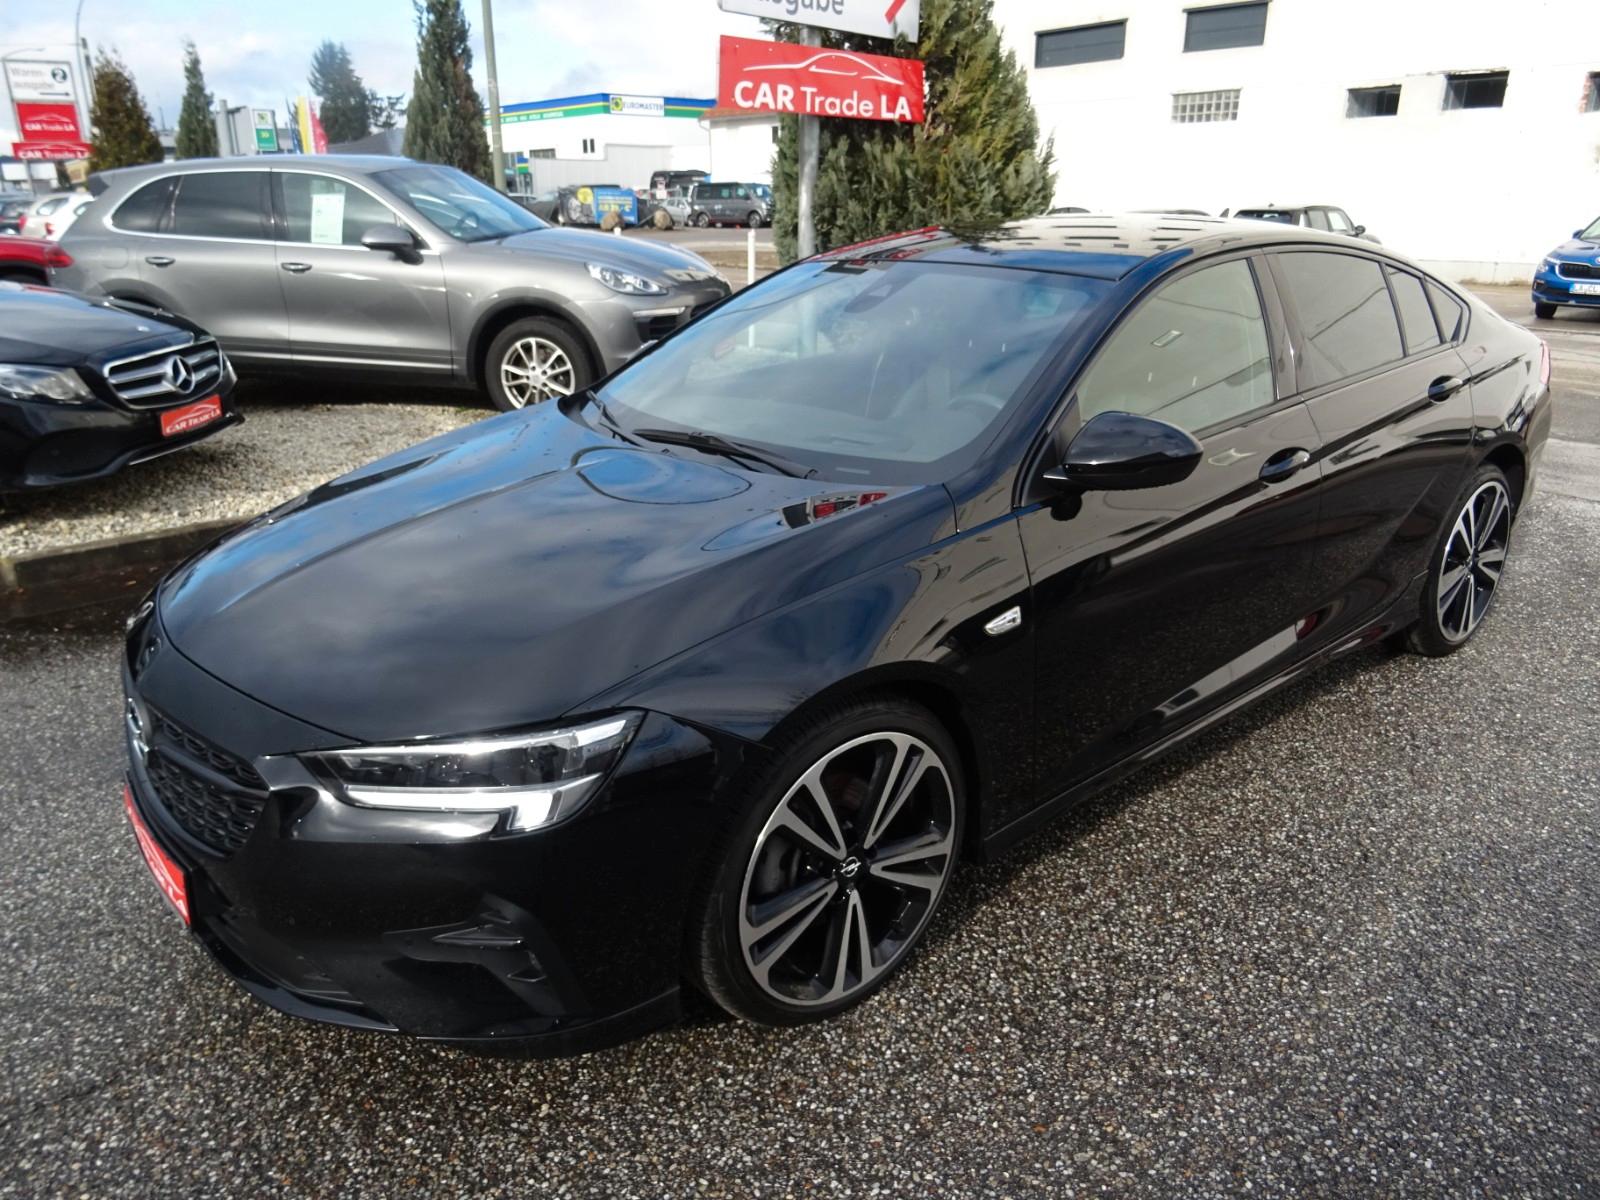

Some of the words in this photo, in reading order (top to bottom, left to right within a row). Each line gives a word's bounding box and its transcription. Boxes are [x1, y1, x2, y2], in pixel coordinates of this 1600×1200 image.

[734, 81, 795, 111] CAR
[800, 87, 874, 116] Trade
[880, 95, 912, 120] LA
[623, 101, 665, 111] EUROMASTER
[24, 122, 43, 131] CAR
[64, 122, 76, 131] LA
[18, 150, 43, 160] CAR
